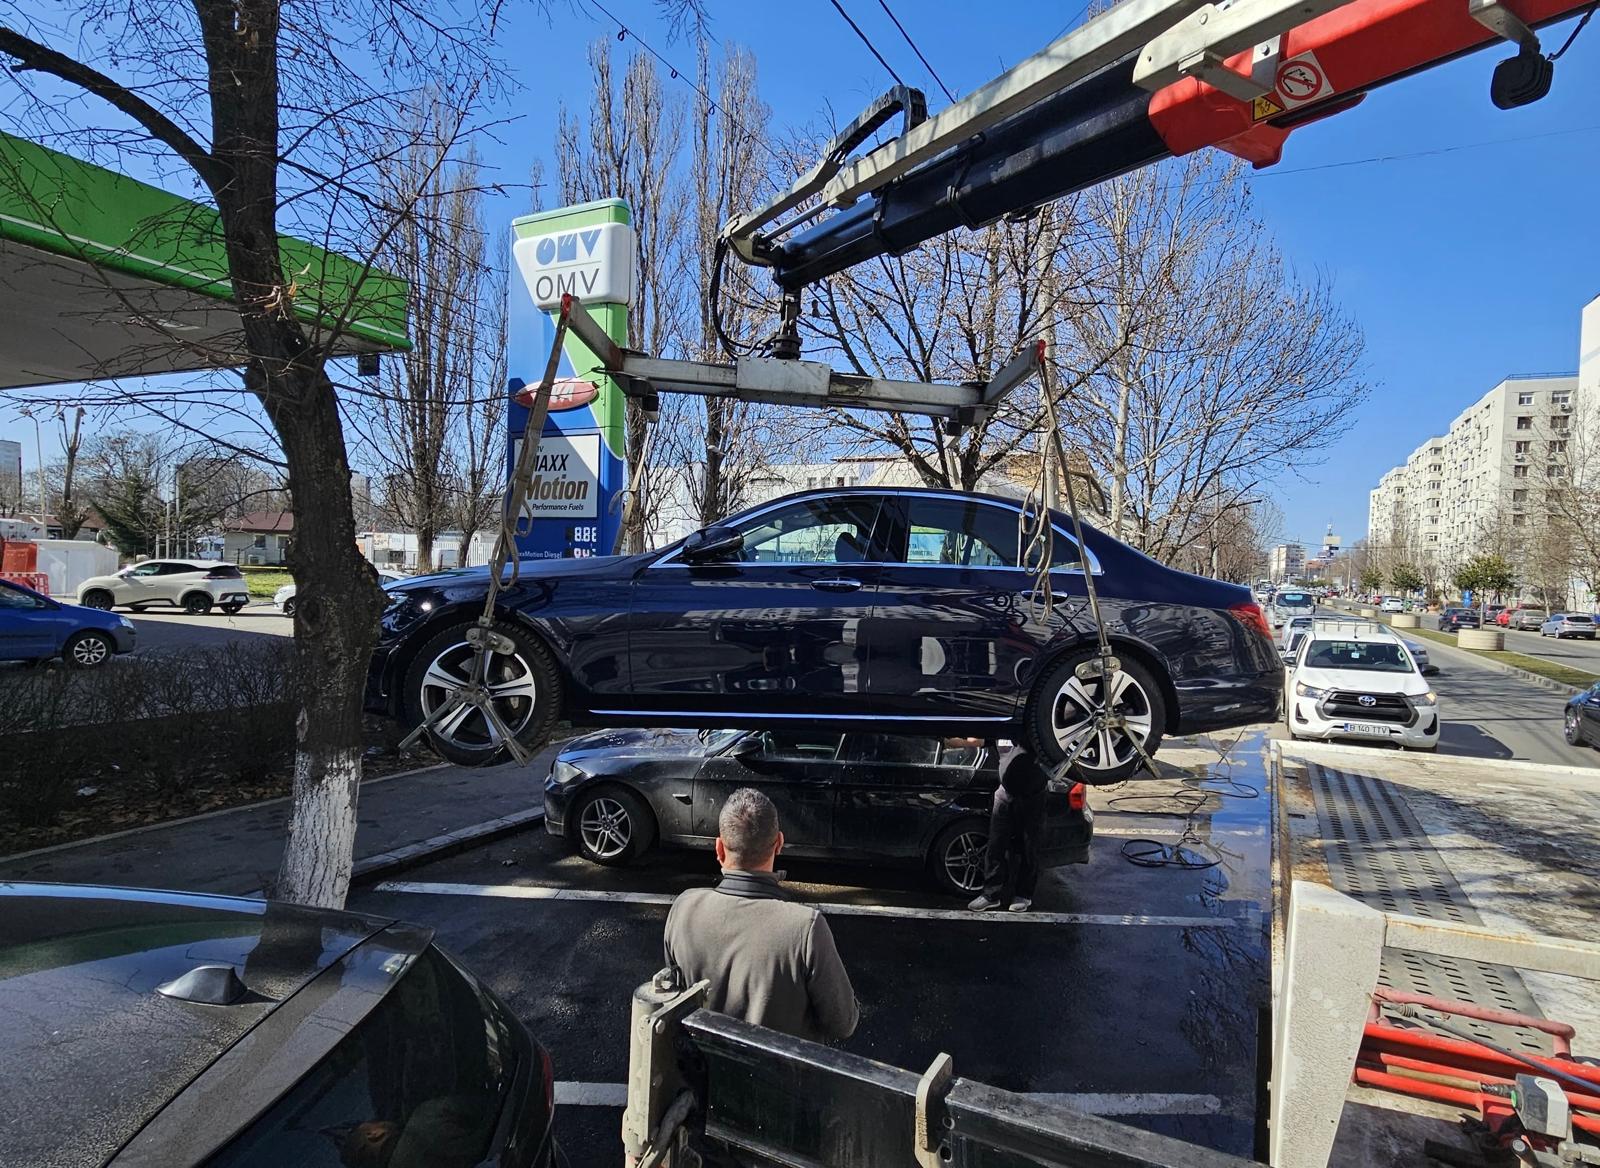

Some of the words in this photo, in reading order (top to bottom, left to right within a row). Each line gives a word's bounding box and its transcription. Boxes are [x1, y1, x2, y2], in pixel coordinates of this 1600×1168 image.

[536, 268, 599, 300] OMV
[527, 474, 589, 500] Motion
[532, 503, 568, 511] Performance
[568, 503, 584, 511] Fuels
